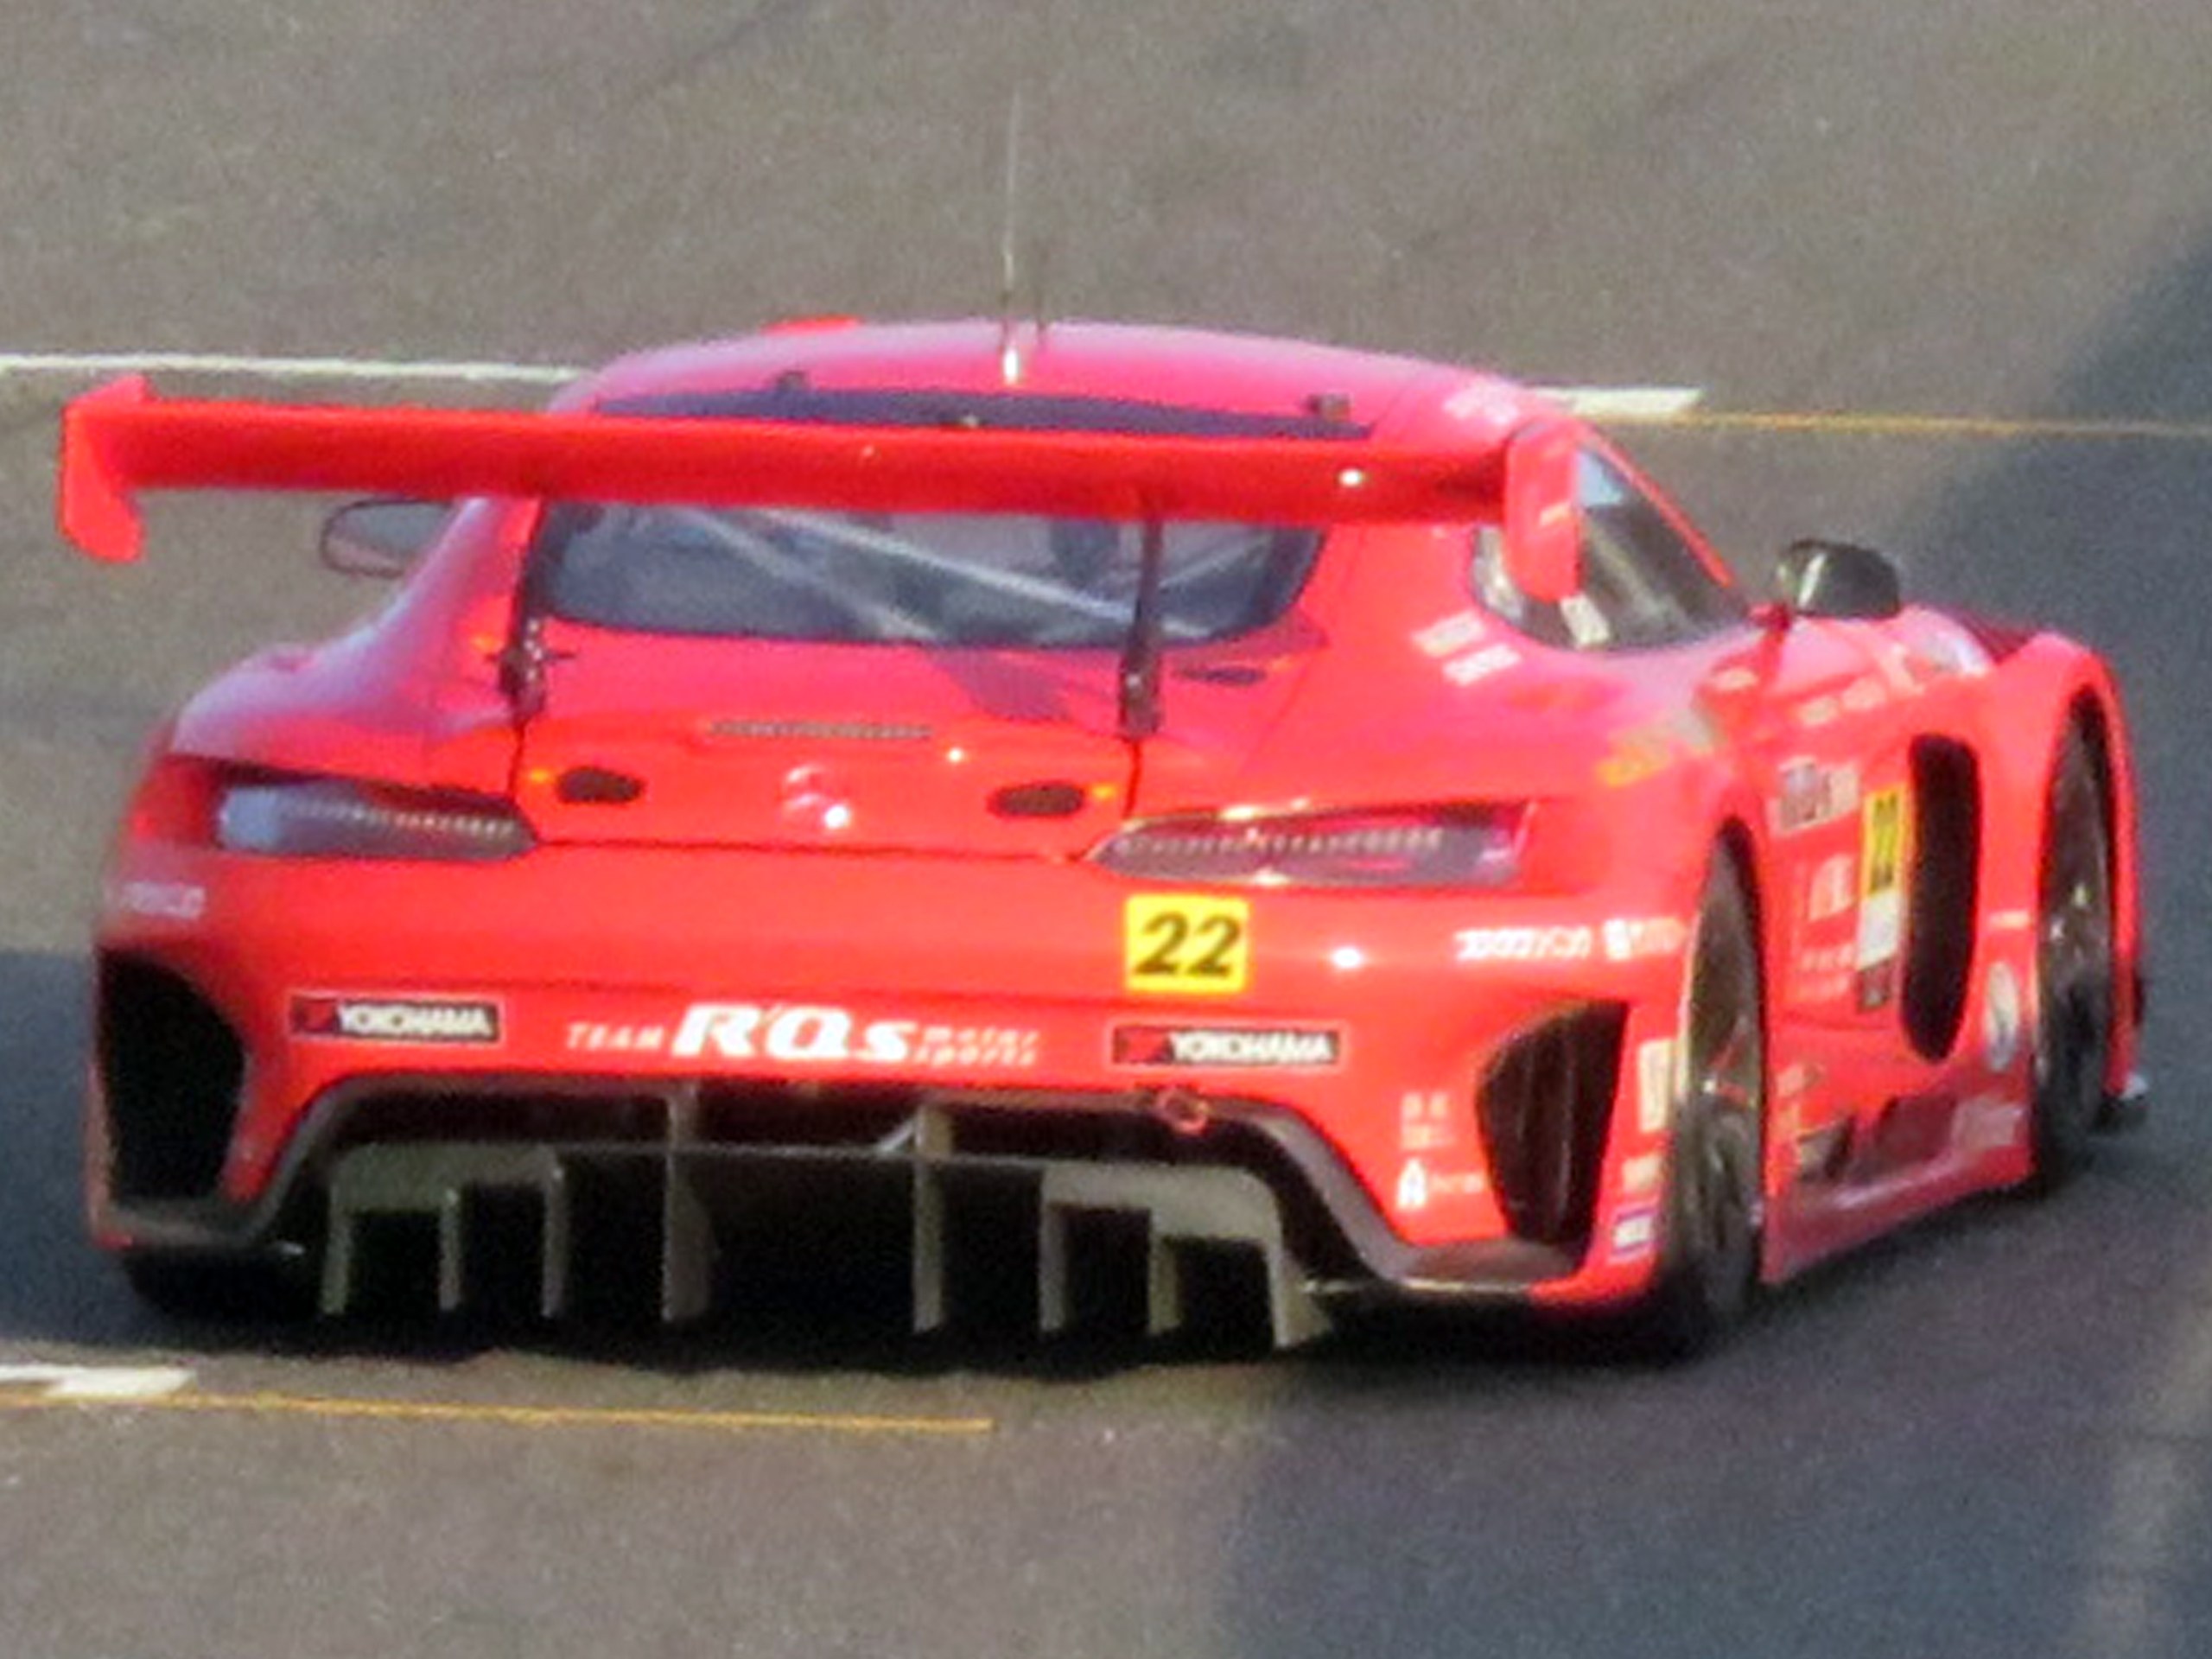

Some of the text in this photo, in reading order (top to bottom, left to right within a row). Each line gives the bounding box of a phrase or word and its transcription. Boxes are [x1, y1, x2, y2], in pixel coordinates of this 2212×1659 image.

[1135, 911, 1242, 977] 22
[337, 1002, 493, 1037] YOKOHAMA
[566, 1022, 665, 1050] TEAM
[1168, 1028, 1333, 1064] YOKOHAMA
